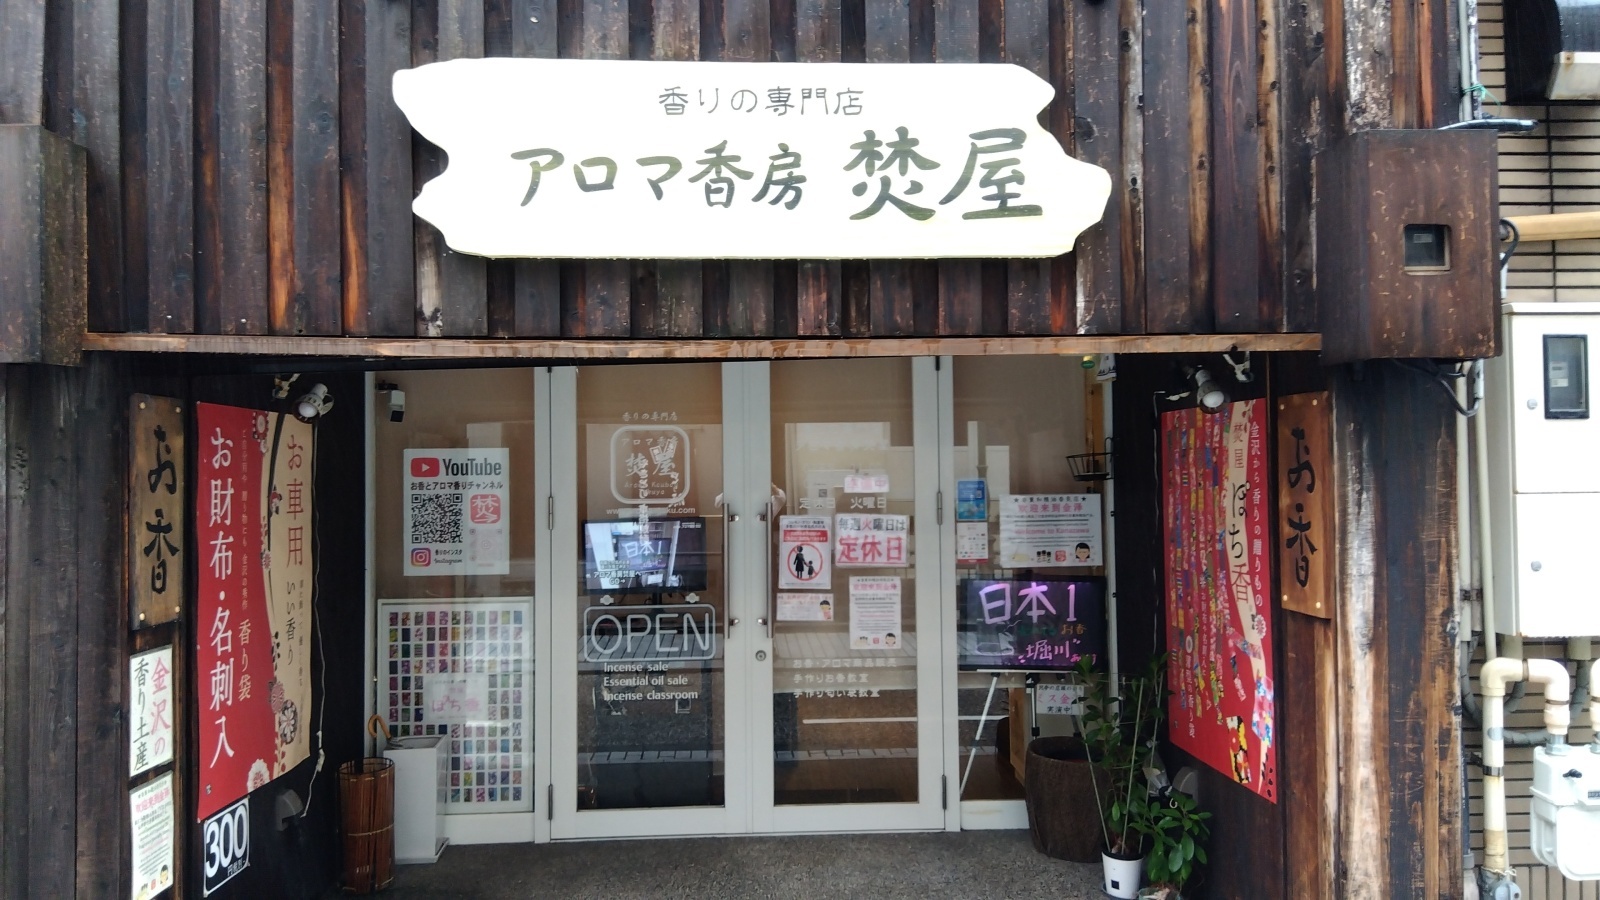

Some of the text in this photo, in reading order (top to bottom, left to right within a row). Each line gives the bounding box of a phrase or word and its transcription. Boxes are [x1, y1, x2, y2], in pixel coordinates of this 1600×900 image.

[659, 87, 864, 117] 香りの専門店
[511, 126, 1043, 221] アロマ香房 焚屋
[622, 411, 678, 422] 香りの専門店
[442, 457, 502, 477] YouTube
[410, 481, 503, 491] お香とアロマ香りチャンネル
[143, 424, 180, 595] お香
[286, 434, 304, 568] お車用
[800, 496, 887, 509] 定日 火曜日
[1286, 426, 1318, 588] お香
[838, 517, 907, 532] 毎週火曜日は
[433, 557, 463, 566] Instagram
[837, 535, 904, 562] 定休日
[208, 427, 235, 769] お財布・名刺入
[590, 612, 710, 655] OPEN
[1061, 623, 1087, 635] お香
[238, 619, 251, 701] 香り袋
[603, 662, 669, 672] Incense sale
[603, 675, 689, 687] Essential oil sale
[793, 673, 869, 684] 手作りお香教室
[150, 656, 171, 756] 金沢の
[603, 689, 699, 701] Incense classroom
[132, 657, 150, 772] 香り土産
[205, 805, 248, 878] 300
